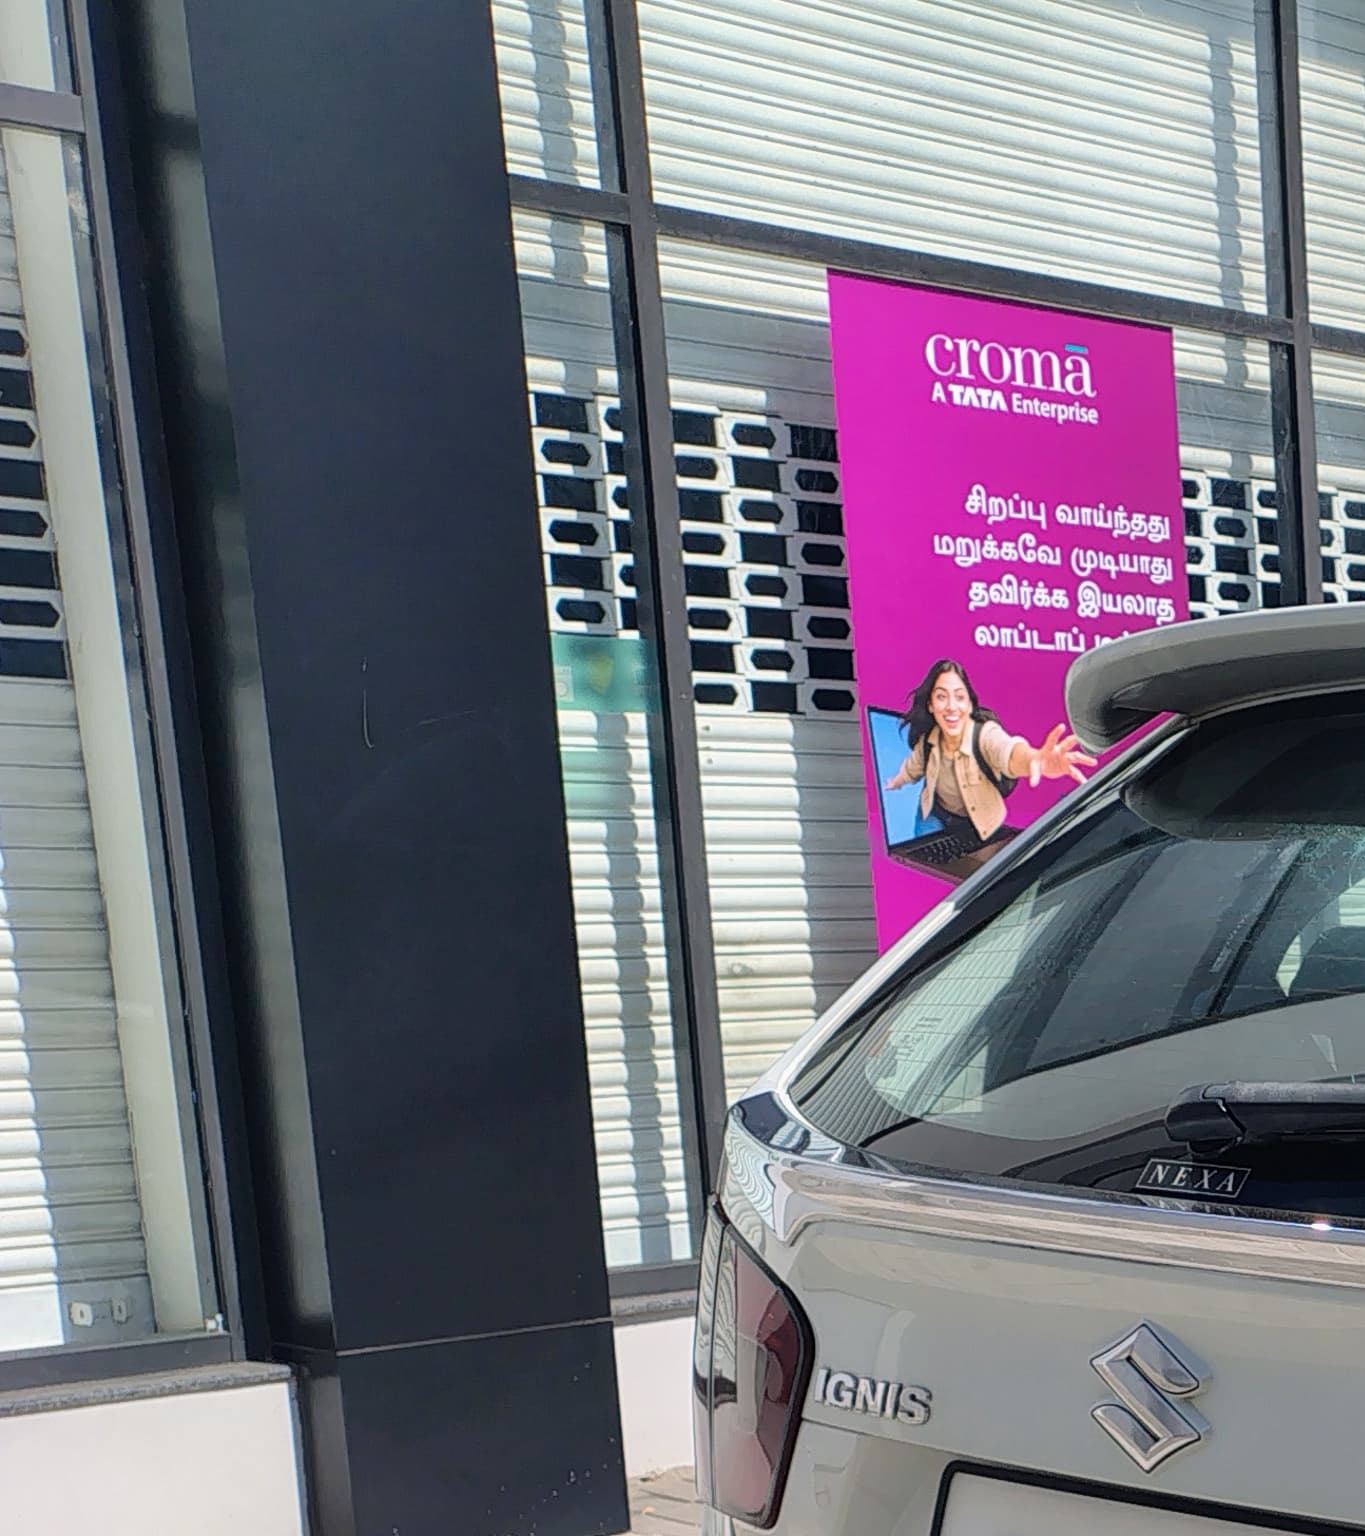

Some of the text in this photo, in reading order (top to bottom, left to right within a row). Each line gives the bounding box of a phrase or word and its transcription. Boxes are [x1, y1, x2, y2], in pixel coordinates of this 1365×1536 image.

[931, 381, 1099, 424] A TATA Enterprise
[965, 484, 1171, 543] சிறப்பு வாய்ந்தது
[933, 532, 1174, 584] மறுக்கவே முடியாது
[968, 573, 1176, 625] தவிர்க்க இயலாத
[974, 622, 1086, 653] லாப்டாப்
[1147, 1164, 1236, 1192] NEXA
[814, 1367, 934, 1426] IGNIS
